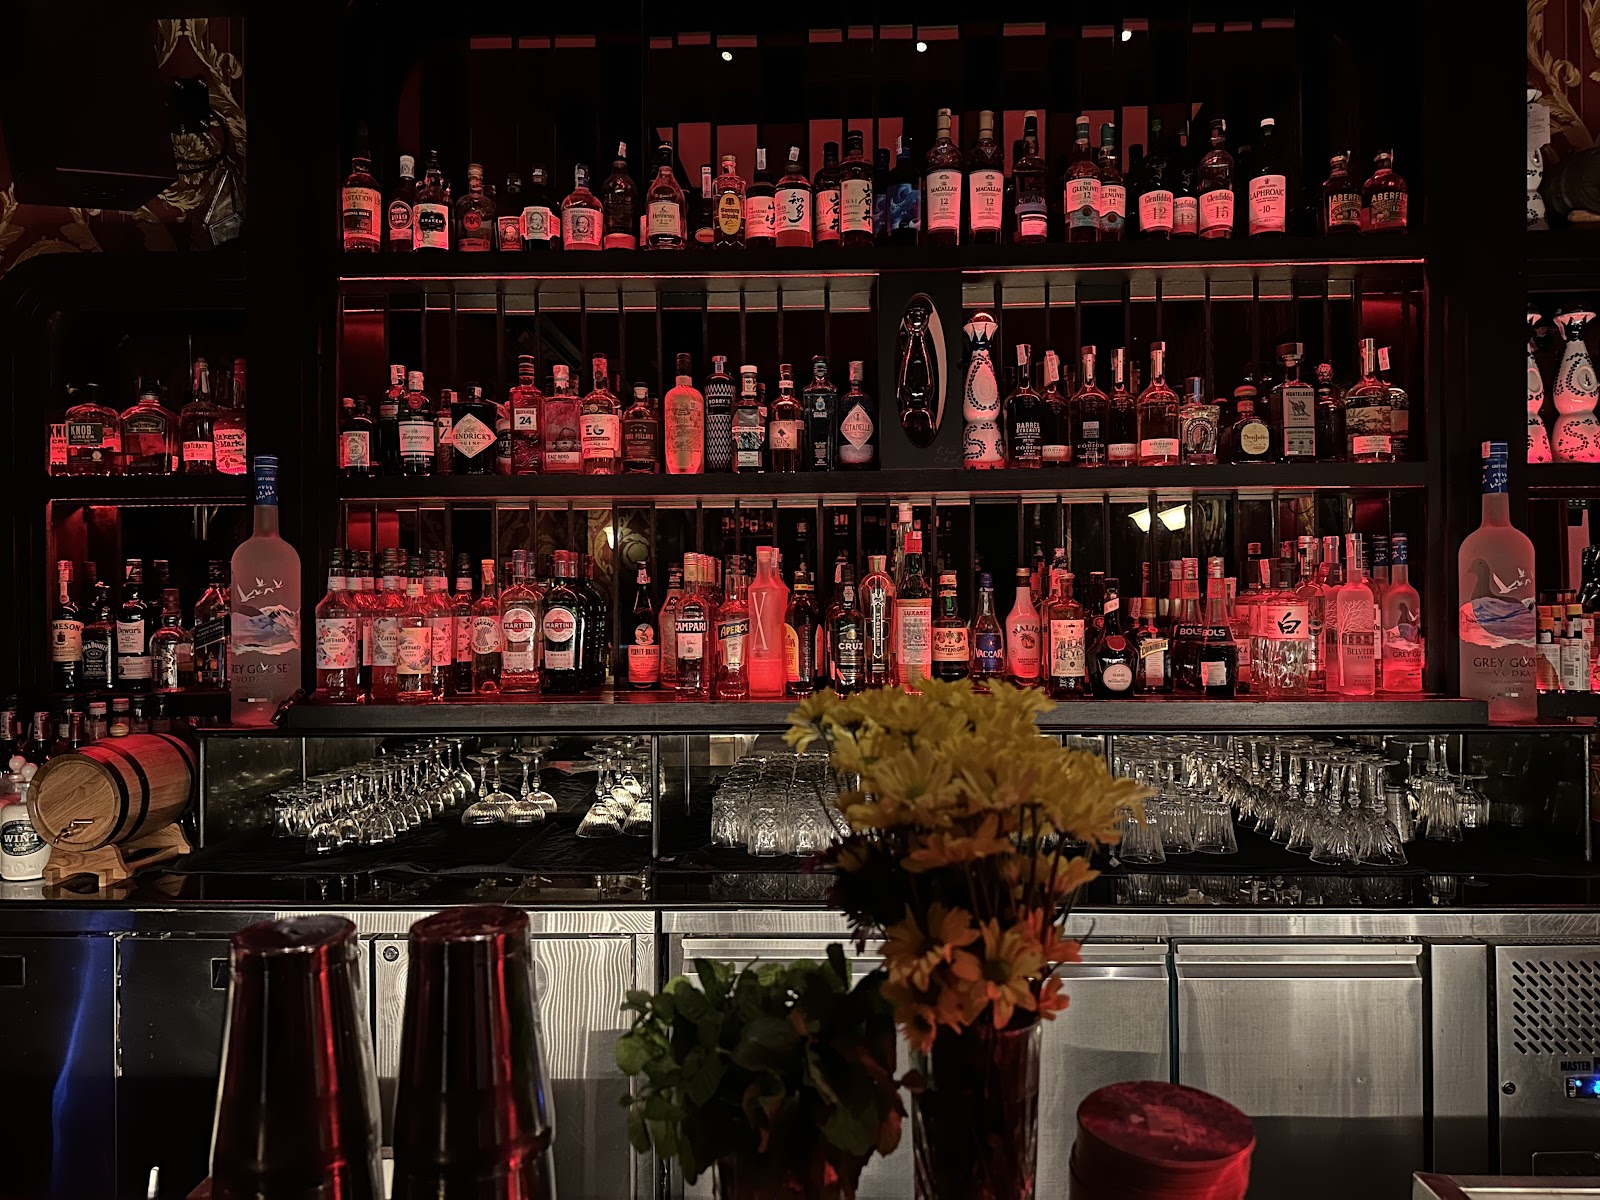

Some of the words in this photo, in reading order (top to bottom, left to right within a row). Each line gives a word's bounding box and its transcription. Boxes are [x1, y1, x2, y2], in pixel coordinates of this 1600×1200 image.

[930, 185, 958, 194] MACALLAN
[975, 186, 1002, 194] MACALLAN
[1249, 188, 1285, 200] LAPHROAIG
[1083, 191, 1092, 199] 12
[1144, 192, 1172, 204] Glenfiddich
[939, 197, 949, 206] 12
[1018, 197, 1047, 206] SCAPA
[721, 206, 740, 215] Suntory
[1152, 207, 1167, 220] 12
[1214, 205, 1229, 219] 15
[1350, 208, 1358, 218] 16
[653, 212, 676, 221] Hennessy
[721, 212, 740, 221] Whisky
[708, 397, 731, 405] BOBBY'S
[519, 415, 533, 425] 24
[585, 424, 605, 435] EG
[844, 423, 871, 432] CITADELLE
[1016, 421, 1041, 429] BARREL
[70, 425, 93, 436] KNOB
[401, 433, 431, 442] Tanqueray
[635, 433, 655, 441] PILLARS
[504, 621, 533, 629] MARTINI
[545, 621, 573, 629] MARTINI
[675, 621, 707, 632] CAMPARI
[720, 623, 749, 637] APEROL
[1179, 627, 1202, 635] BOLS
[1201, 629, 1226, 637] BOLS
[838, 642, 864, 650] CRUZ
[934, 643, 966, 653] MONTENEGRO
[1142, 643, 1167, 655] COINTREAU
[1055, 648, 1084, 661] REYES
[1473, 657, 1507, 668] GREY
[247, 662, 291, 674] GOOSE
[1494, 669, 1532, 678] VODKA
[3, 832, 39, 843] WINT
[1560, 1060, 1592, 1071] MASTER
